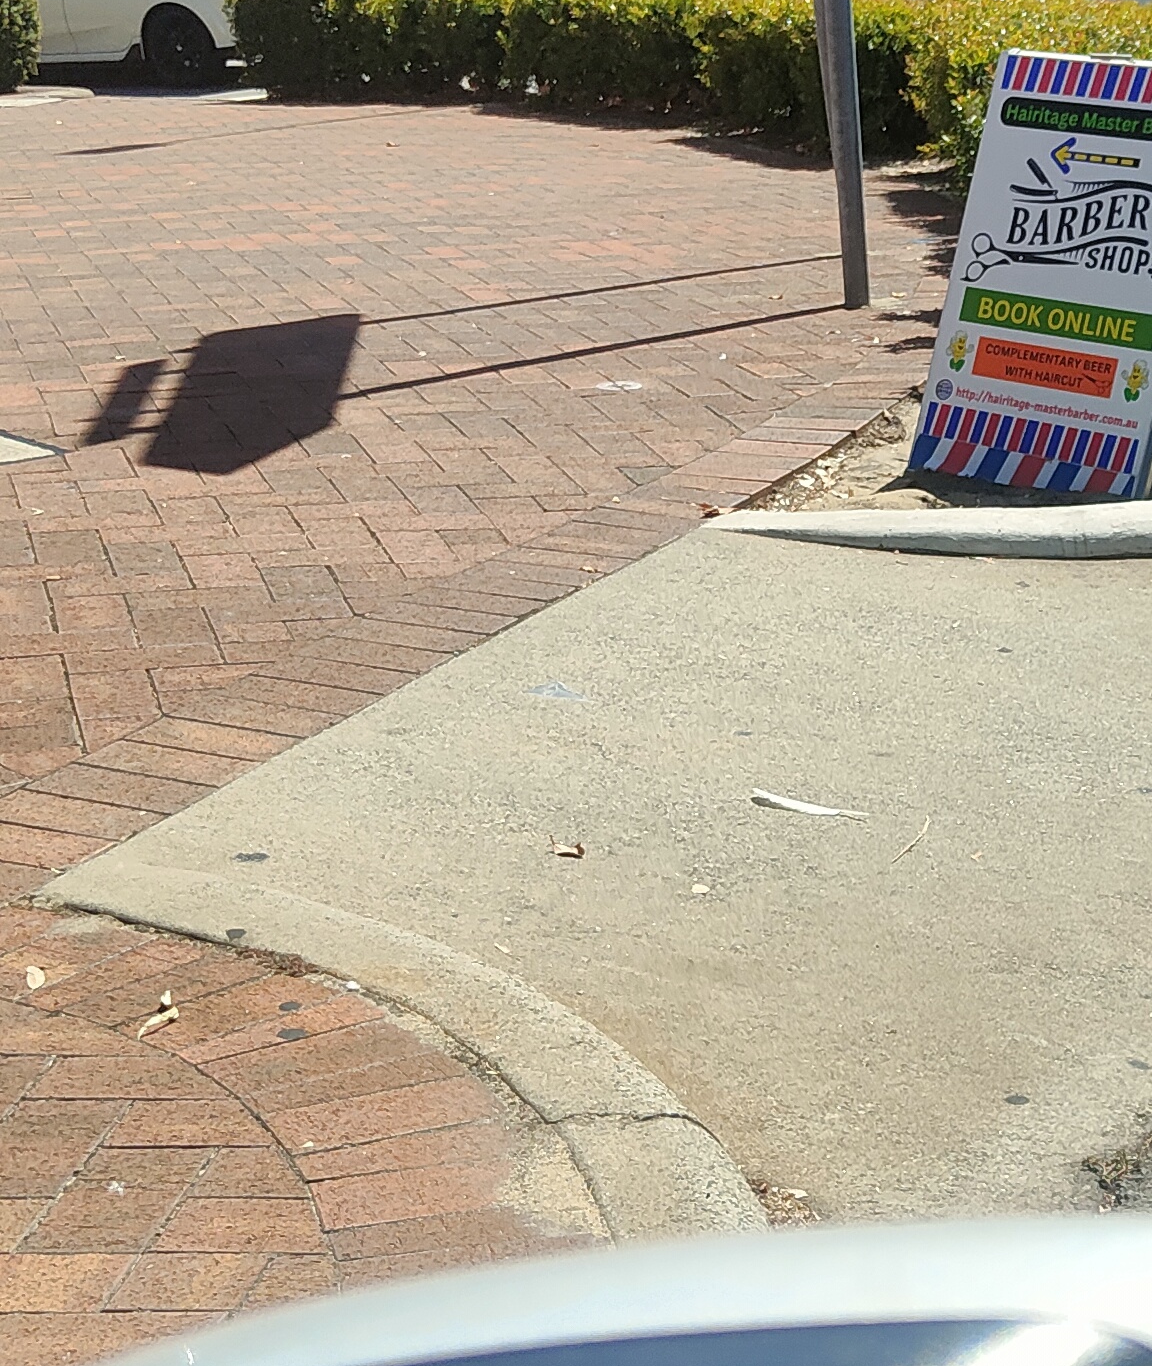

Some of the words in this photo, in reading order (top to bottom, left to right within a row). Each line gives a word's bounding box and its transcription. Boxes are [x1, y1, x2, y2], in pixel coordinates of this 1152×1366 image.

[1006, 104, 1079, 130] Hairitage
[1081, 112, 1139, 131] Master
[1005, 194, 1150, 246] BARBER
[1084, 246, 1150, 275] SHOP
[977, 297, 1044, 327] BOOK
[1047, 308, 1137, 342] ONLINE
[985, 343, 1081, 369] COMPLEMENTARY
[1083, 359, 1112, 374] BEER
[1004, 365, 1032, 379] WITH
[1034, 370, 1084, 388] HAIRCUT
[955, 386, 1139, 429] http://hairitage-masterbarber.com.au
